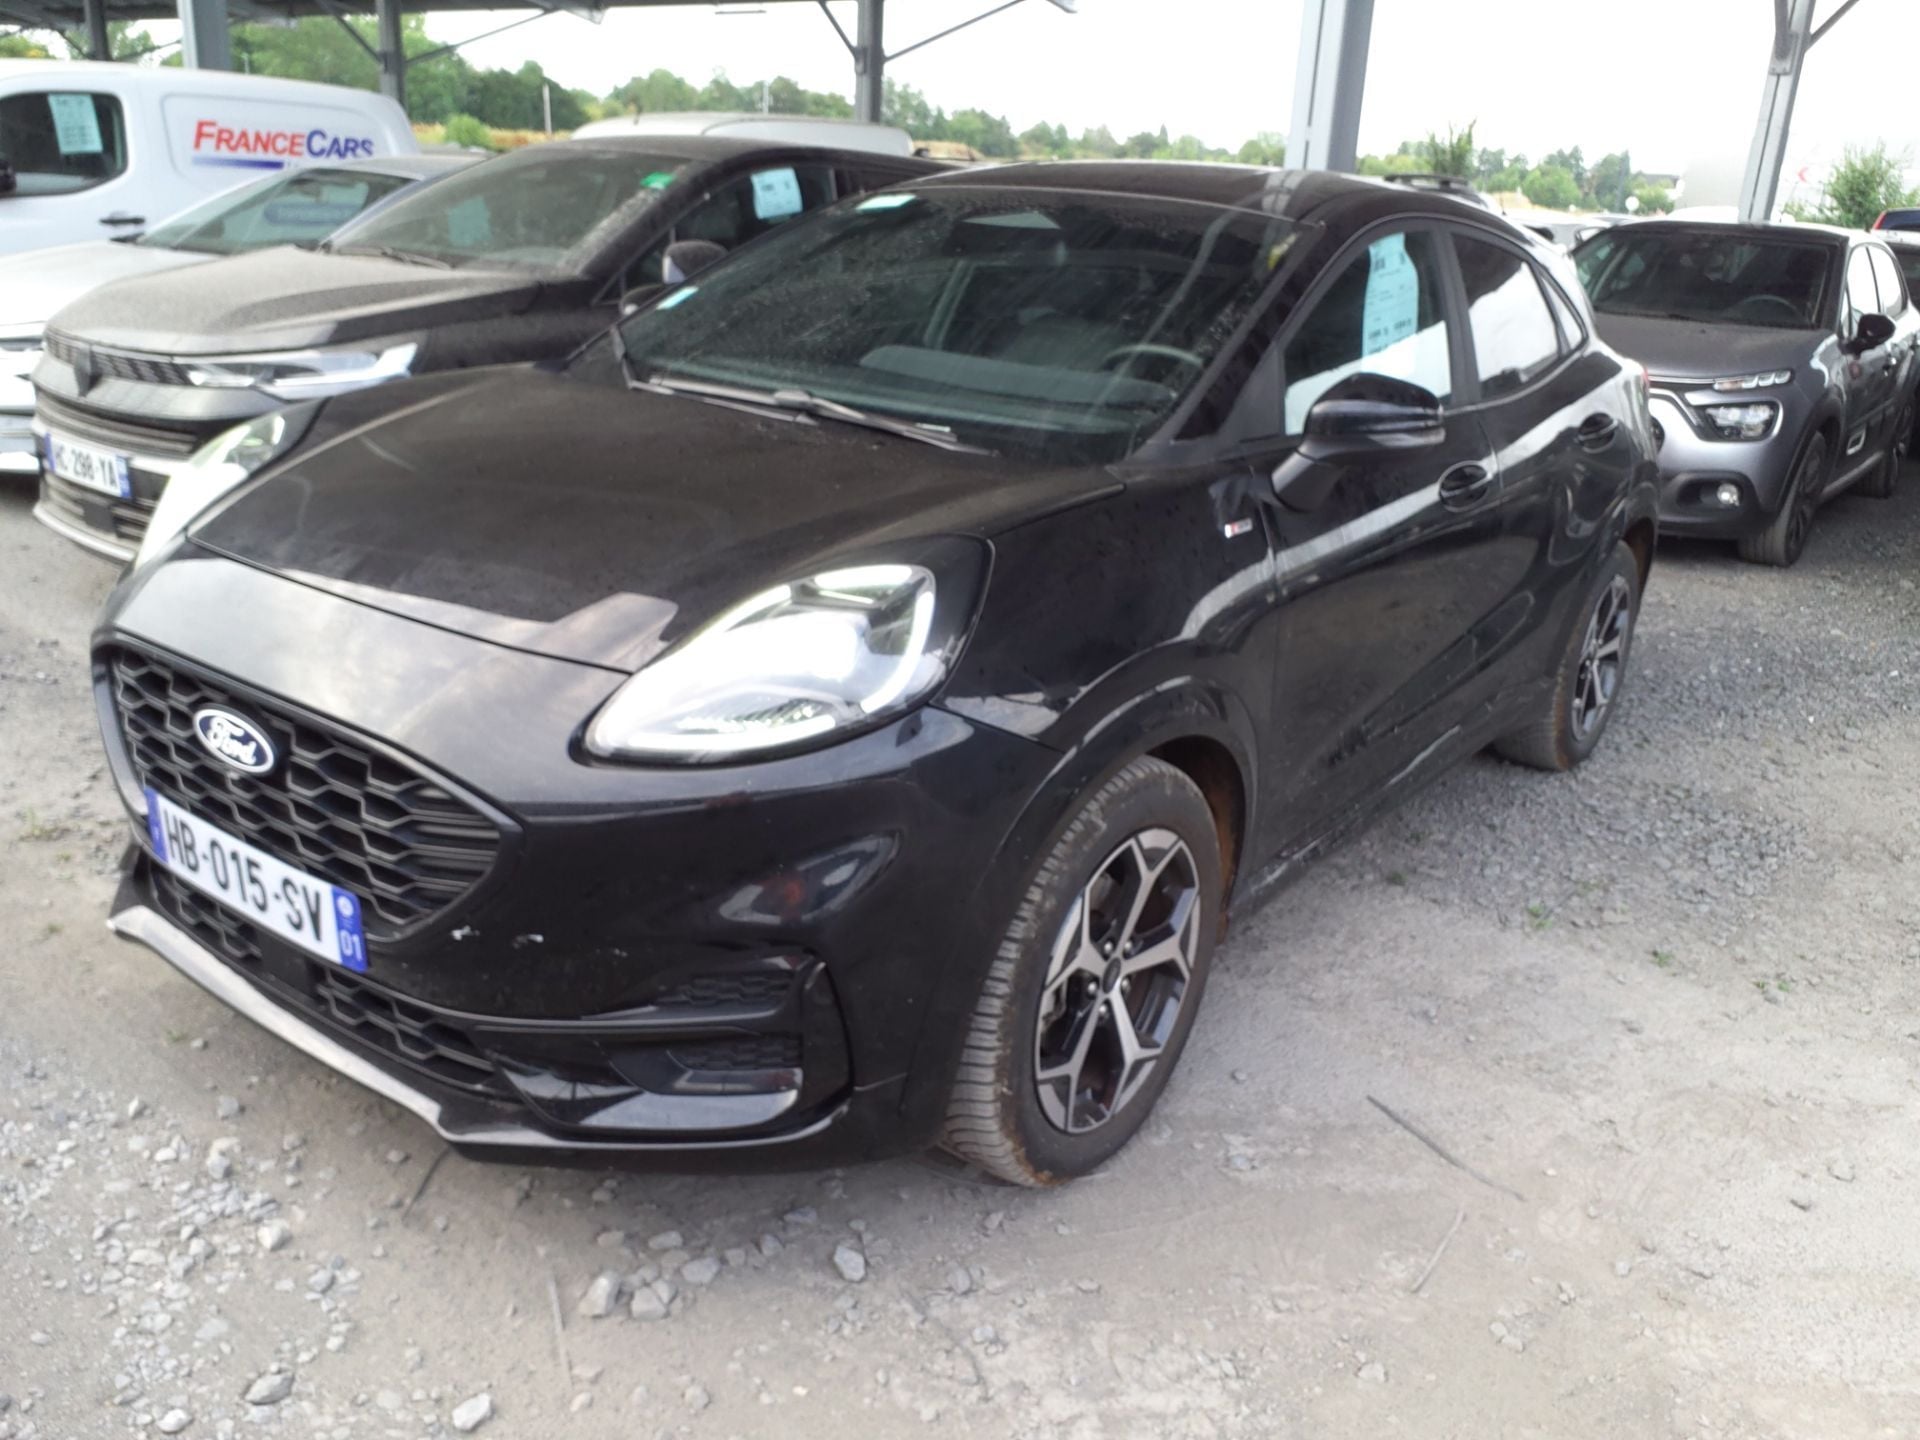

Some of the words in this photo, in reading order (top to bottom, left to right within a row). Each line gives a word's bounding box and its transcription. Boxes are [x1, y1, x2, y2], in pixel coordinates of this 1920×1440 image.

[207, 717, 256, 765] Ford
[163, 810, 322, 942] HB-015-SV
[339, 929, 363, 961] 01
